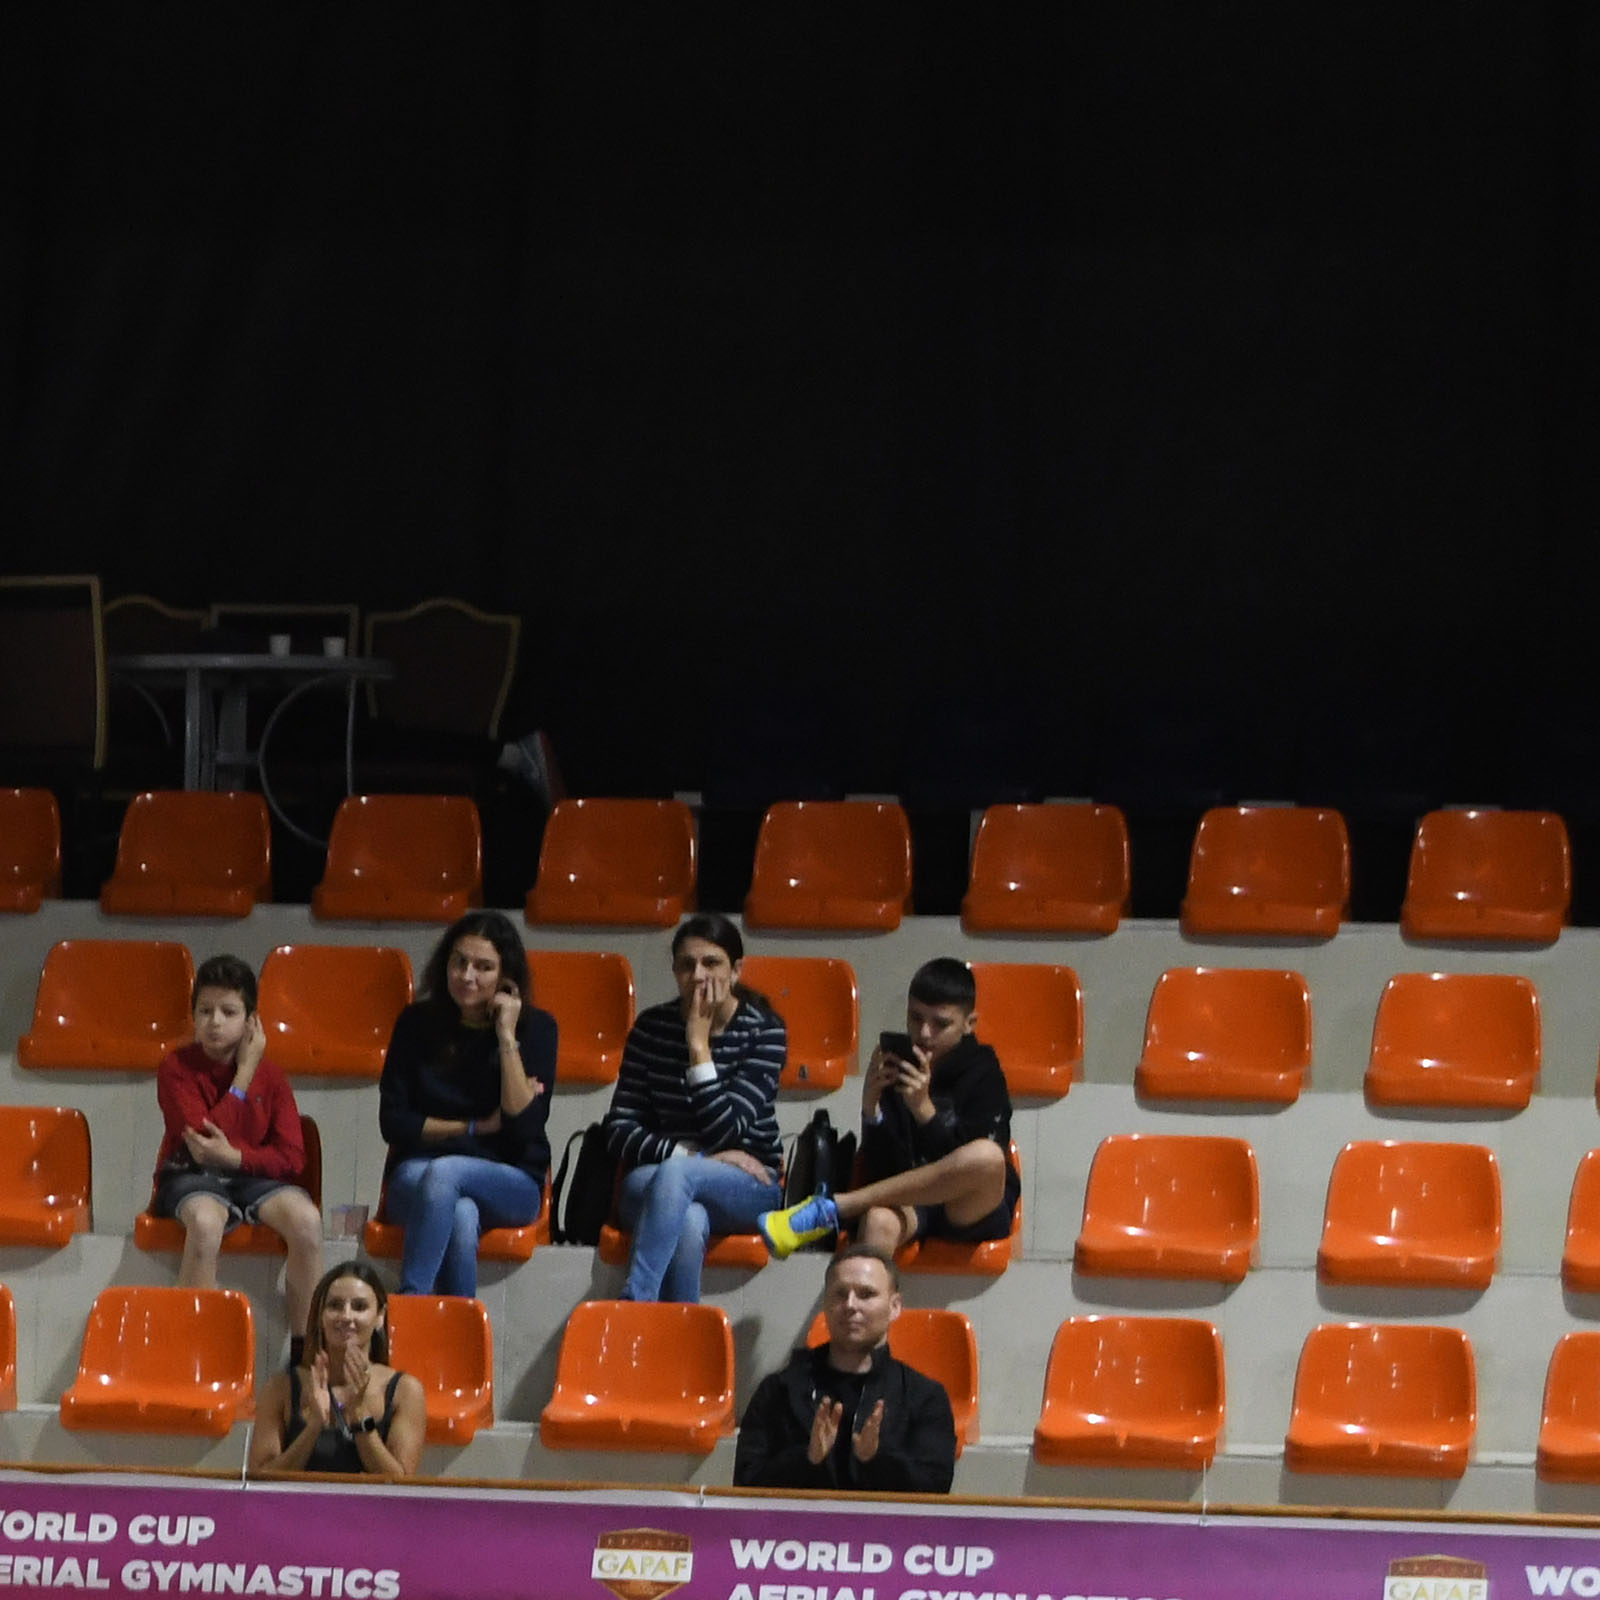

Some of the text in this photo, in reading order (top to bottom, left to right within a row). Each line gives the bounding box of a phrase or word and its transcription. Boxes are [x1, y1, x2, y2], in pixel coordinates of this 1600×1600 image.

[128, 1514, 215, 1546] CUP
[597, 1553, 689, 1578] GAPAF
[730, 1538, 893, 1574] WORLD
[903, 1544, 995, 1577] CUP
[120, 1559, 401, 1600] GYMNASTICS
